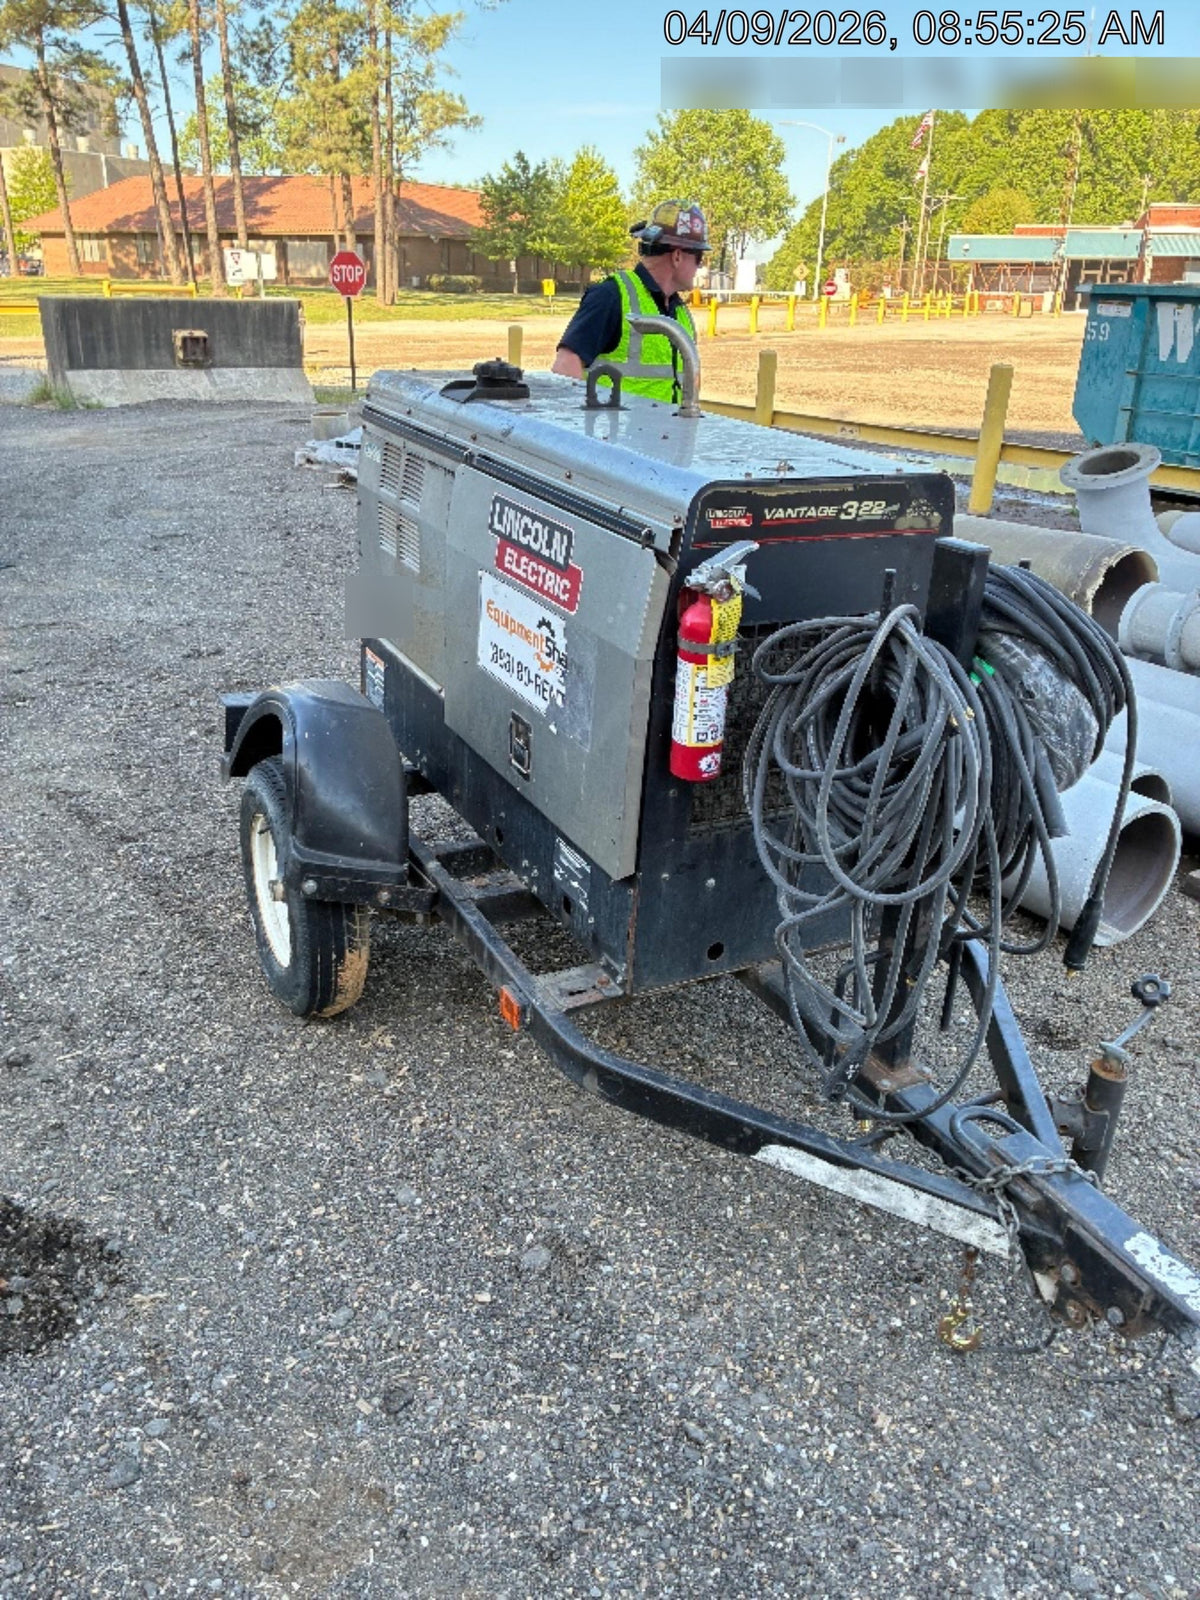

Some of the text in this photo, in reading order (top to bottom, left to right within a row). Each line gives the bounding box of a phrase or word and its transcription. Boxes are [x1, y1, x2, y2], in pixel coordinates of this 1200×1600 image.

[333, 265, 363, 282] STOP
[764, 505, 839, 520] VANTAGE
[840, 500, 886, 520] 322
[493, 503, 568, 567] LINCOLN
[504, 547, 571, 602] ELECTRIC
